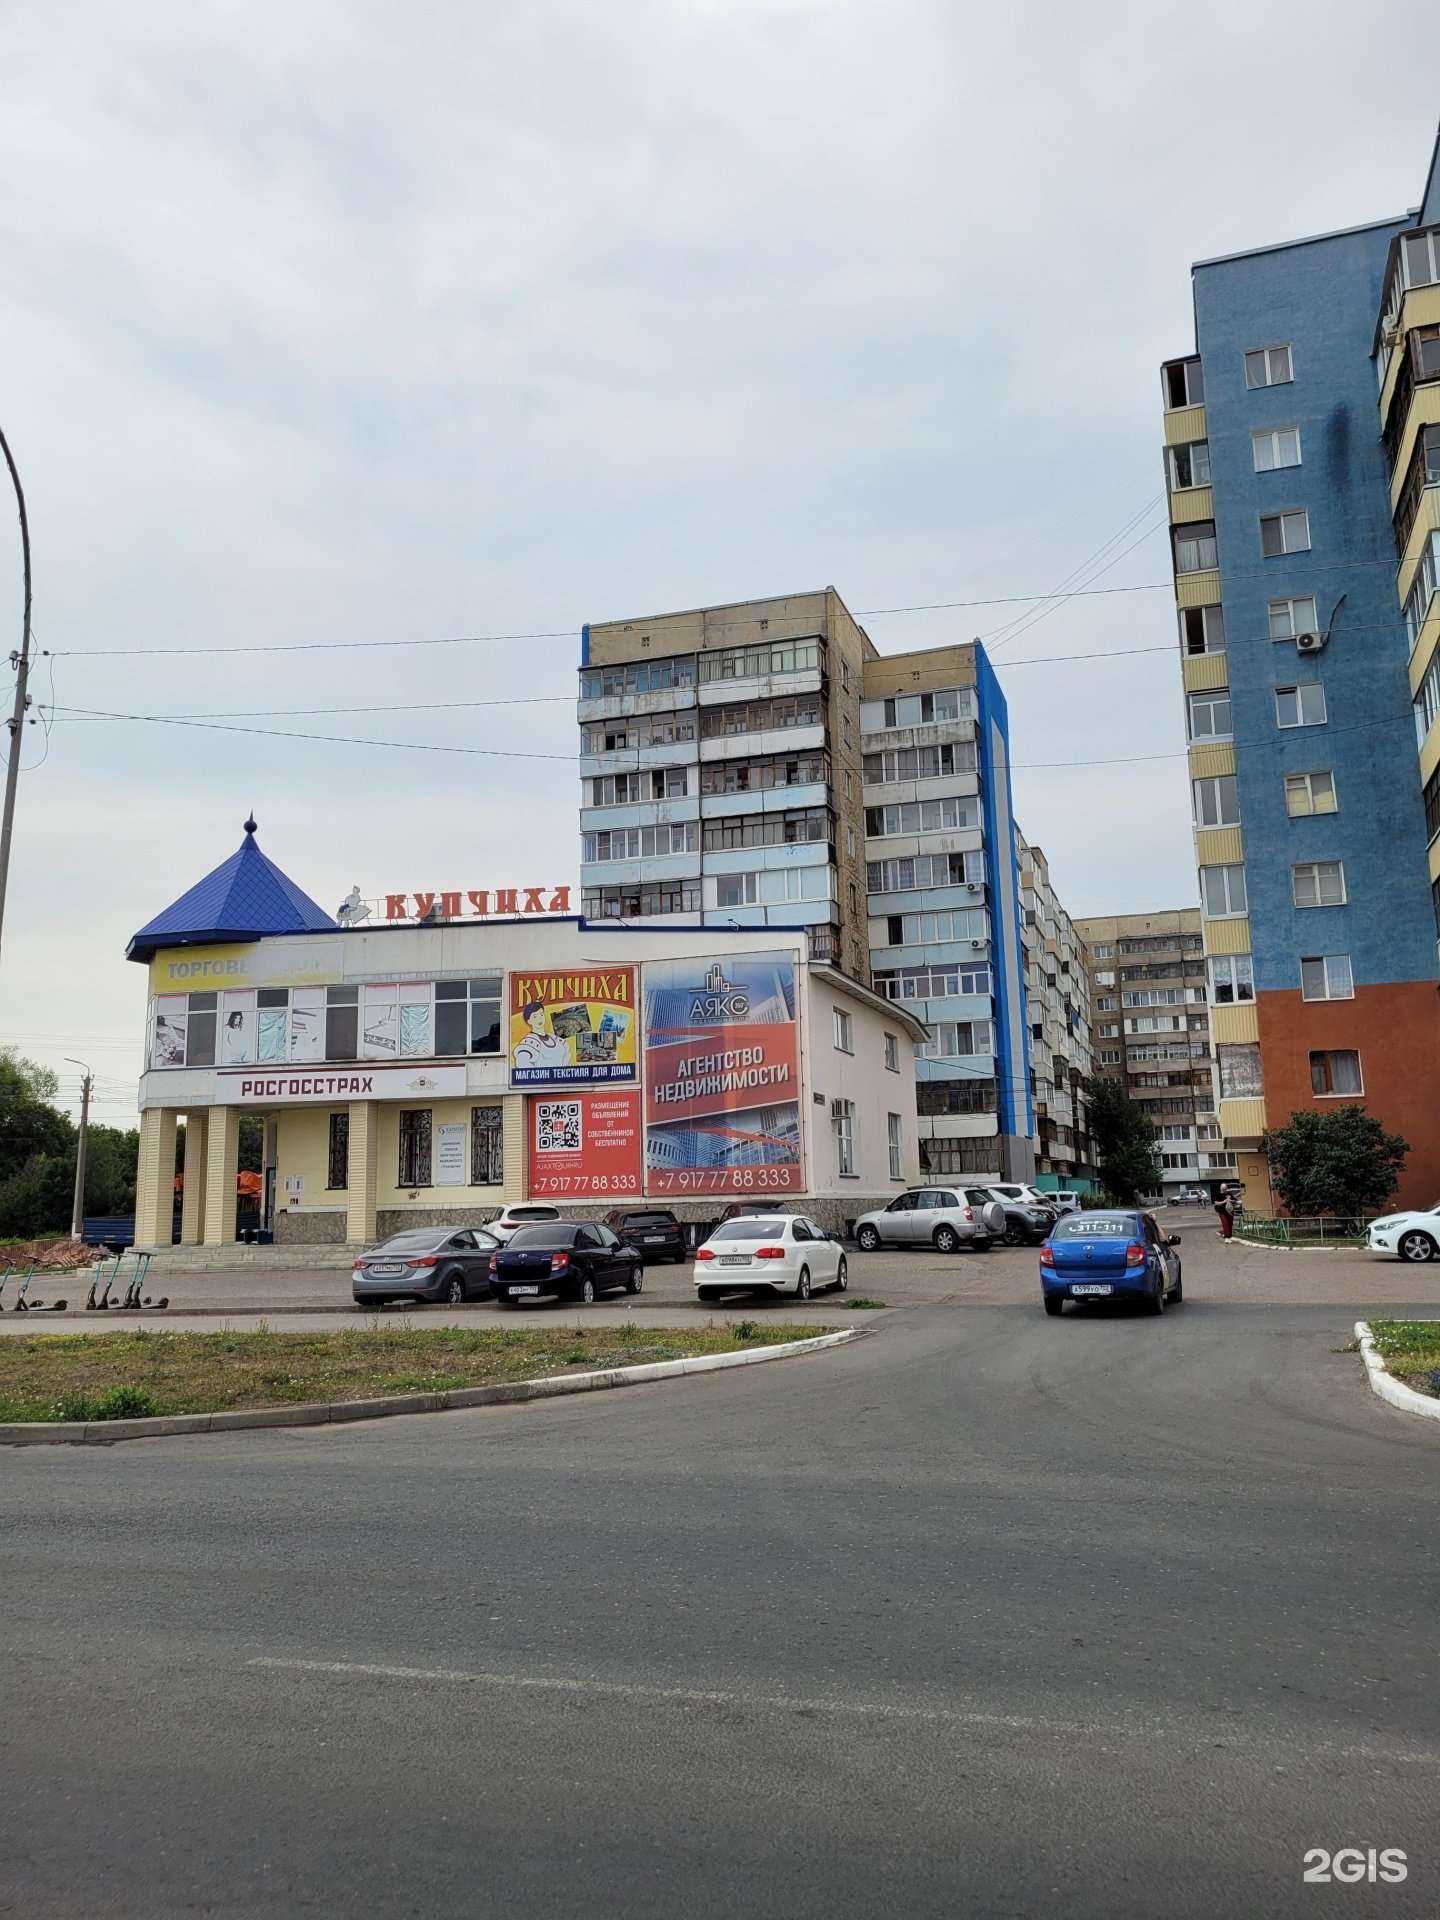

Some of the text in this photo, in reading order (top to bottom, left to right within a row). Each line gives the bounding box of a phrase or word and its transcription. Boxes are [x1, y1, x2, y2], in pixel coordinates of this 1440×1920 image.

[385, 886, 571, 919] КУПЧИХА
[517, 975, 628, 1008] КУПЧИХА
[689, 995, 749, 1018] АЯКС
[515, 1065, 632, 1080] МАГАЗИН ТЕКСТИЛЯ ДЛЯ ДОМА
[677, 1046, 764, 1078] АГЕНТСТВО
[241, 1077, 374, 1097] РОСГОССТРАХ
[654, 1063, 789, 1103] НЕДВИЖИМОСТИ
[534, 1174, 637, 1191] +7 917 77 88 333
[657, 1168, 791, 1189] +7 917 77 88 333
